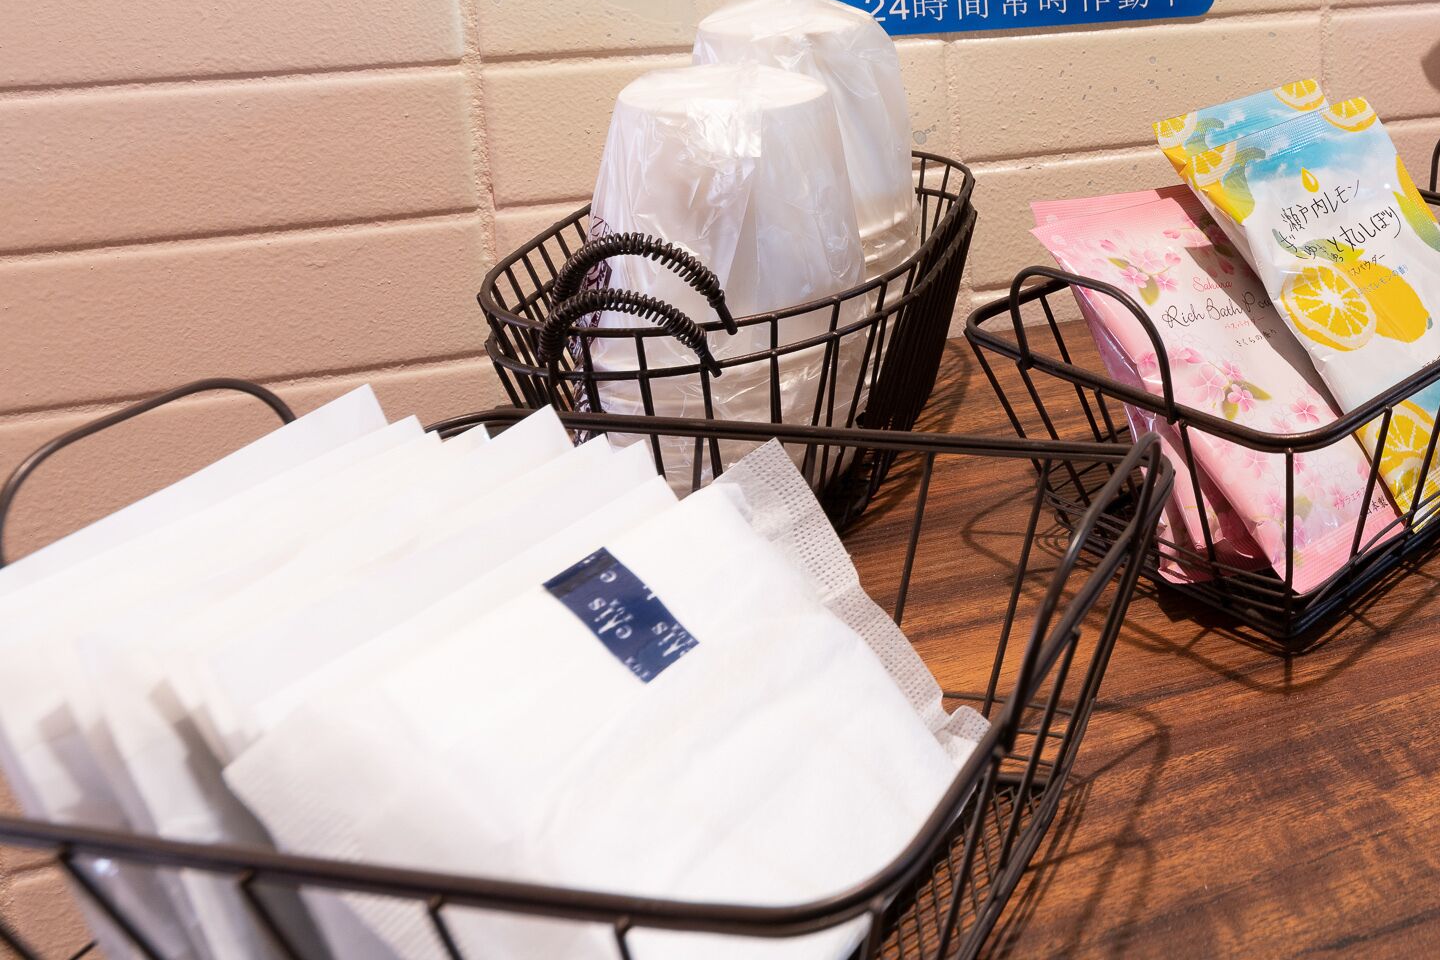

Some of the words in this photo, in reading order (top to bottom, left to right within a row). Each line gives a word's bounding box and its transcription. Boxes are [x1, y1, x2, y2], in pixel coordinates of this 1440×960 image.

[1281, 179, 1360, 232] 瀬戸内レモン
[1192, 276, 1233, 292] Sakura
[1161, 303, 1205, 328] Rich
[1206, 297, 1243, 320] Bath
